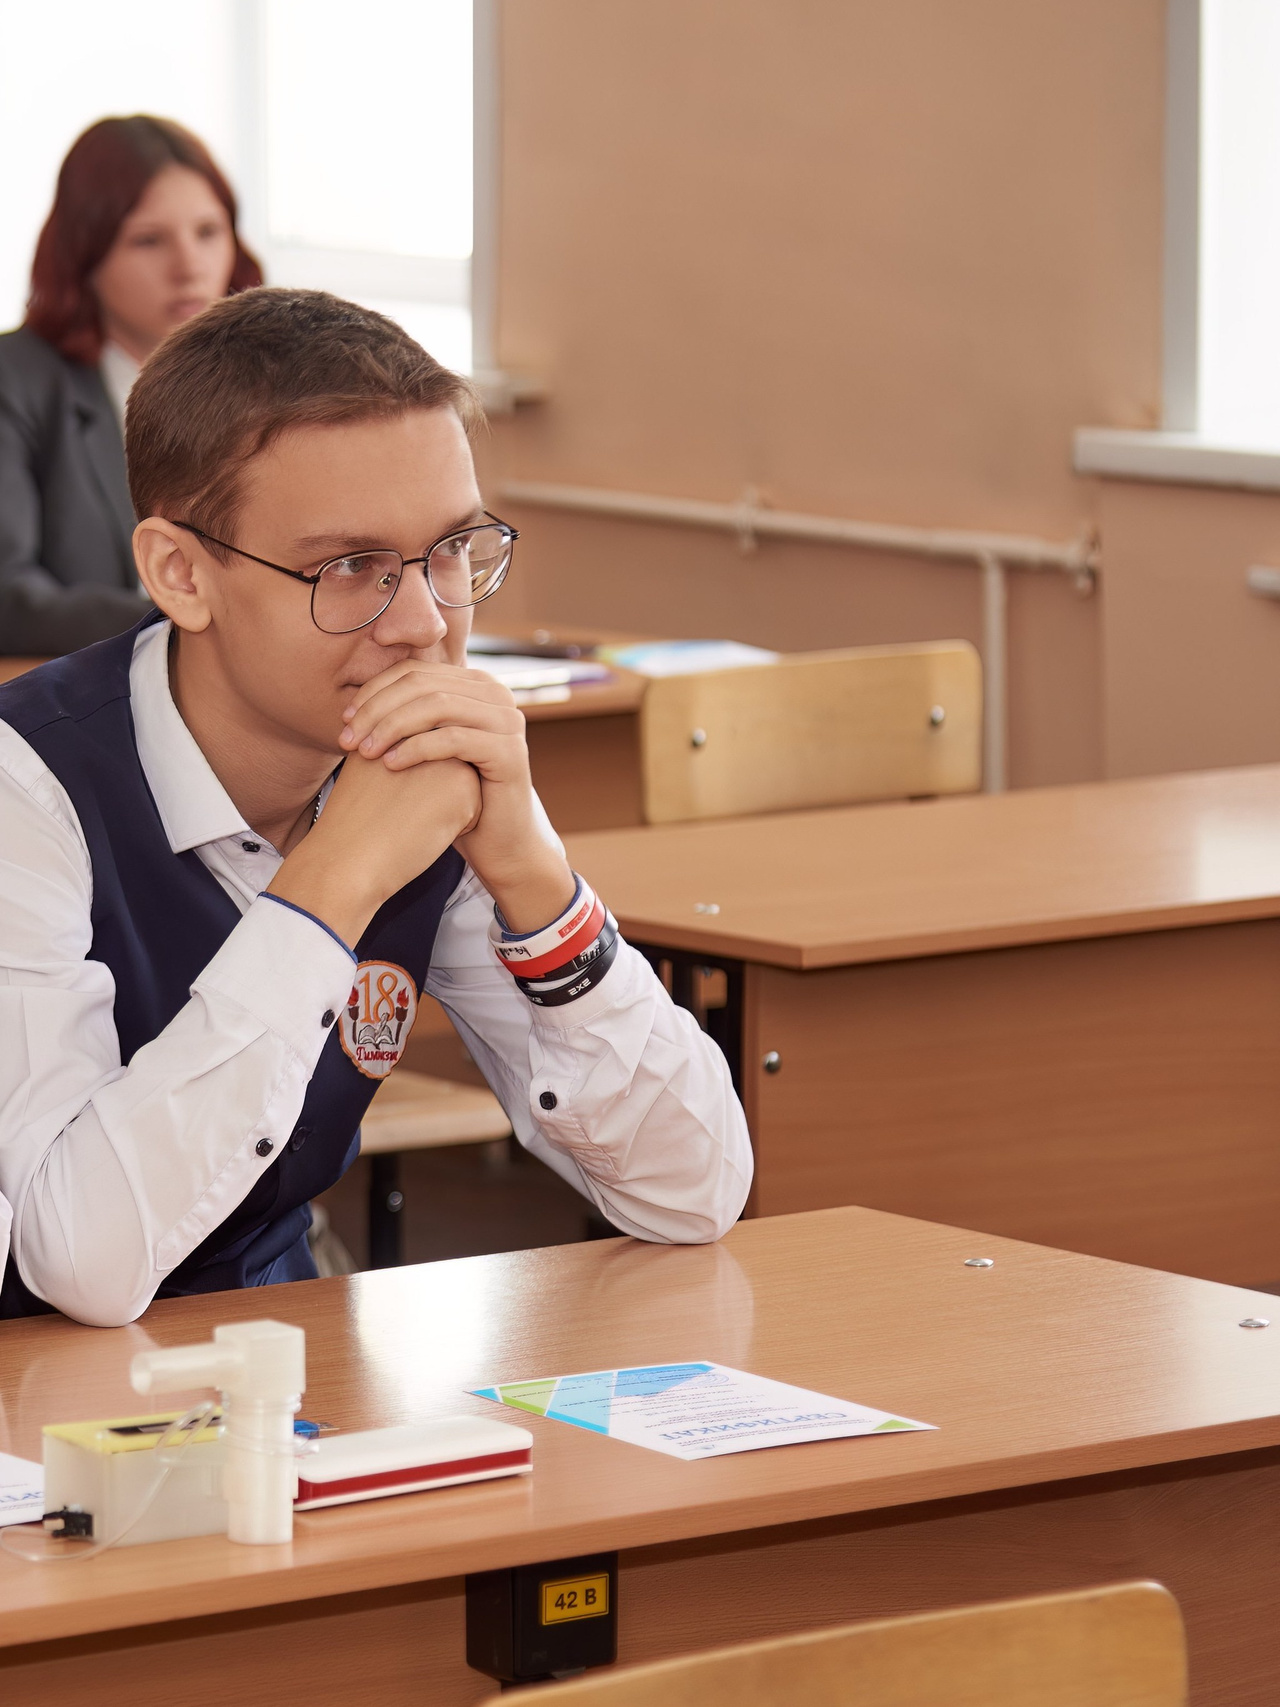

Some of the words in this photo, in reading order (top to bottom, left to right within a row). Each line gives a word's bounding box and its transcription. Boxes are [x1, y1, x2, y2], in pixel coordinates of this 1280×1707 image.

[358, 971, 398, 1024] 18
[658, 1411, 848, 1441] СЕРТИФИКАТ
[554, 1591, 578, 1611] 42
